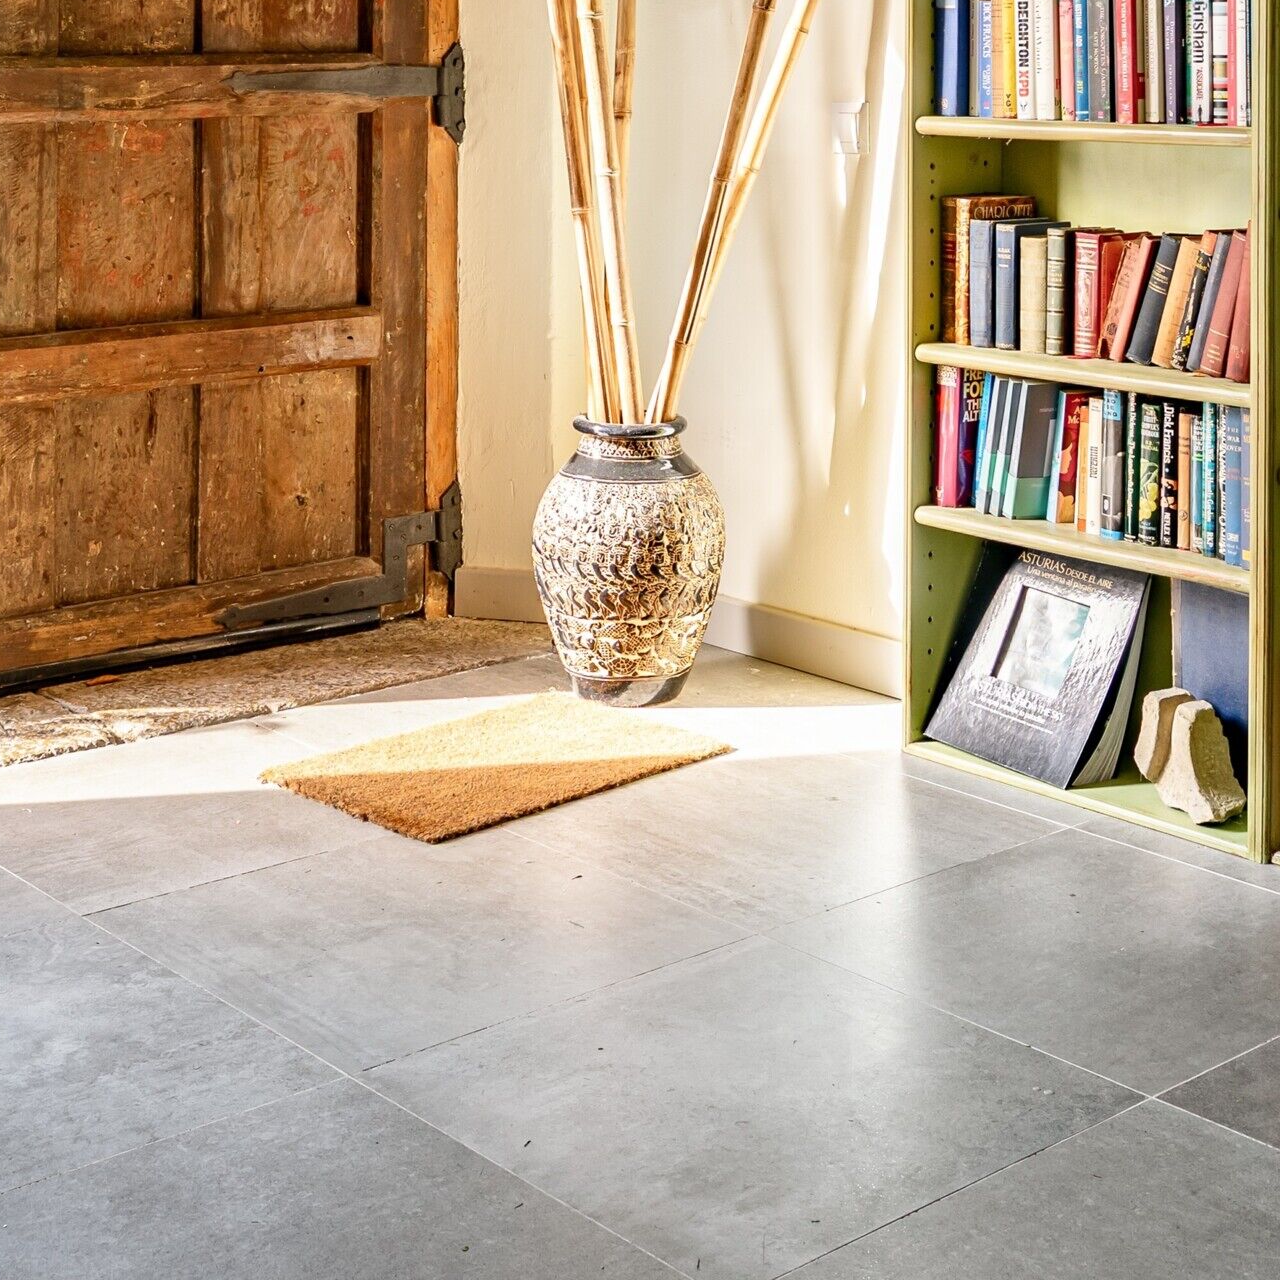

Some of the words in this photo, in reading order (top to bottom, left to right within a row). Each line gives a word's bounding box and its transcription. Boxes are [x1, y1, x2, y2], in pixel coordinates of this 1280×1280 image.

[1017, 0, 1029, 68] DEIGHTON
[1192, 1, 1208, 64] Grisham
[1019, 70, 1029, 97] XPD
[973, 203, 1033, 220] CHARLOTTE
[1163, 406, 1175, 429] Dick
[1163, 428, 1175, 464] Francis
[1163, 512, 1171, 536] REFLEX
[1018, 551, 1067, 574] ASTURIAS
[1065, 567, 1089, 581] DESDE
[1088, 575, 1097, 584] EL
[1097, 578, 1115, 589] AIRE
[1027, 566, 1041, 577] Una
